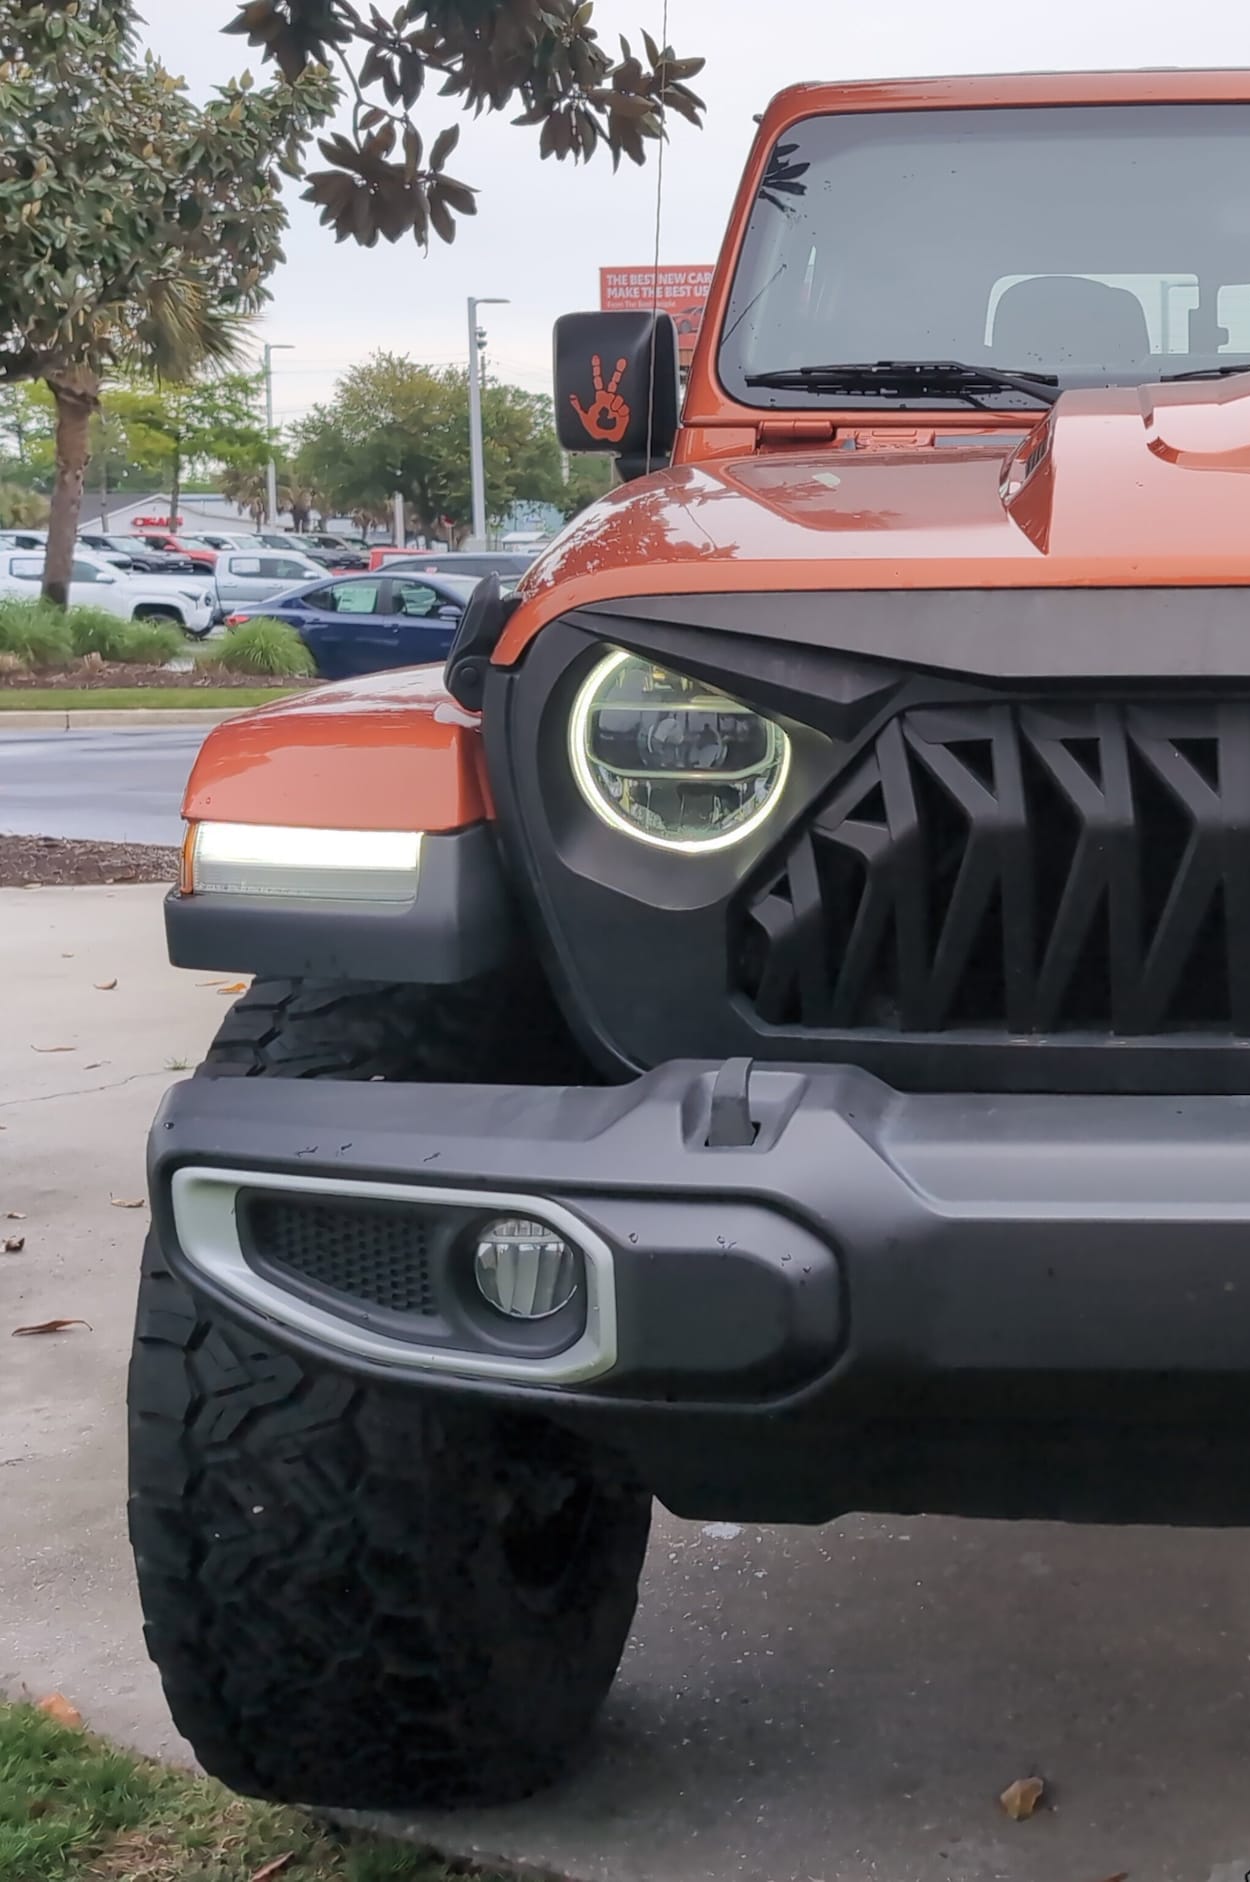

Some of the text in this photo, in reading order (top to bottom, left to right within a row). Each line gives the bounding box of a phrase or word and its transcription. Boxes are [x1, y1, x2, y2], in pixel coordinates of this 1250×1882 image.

[607, 274, 628, 285] THE
[630, 273, 655, 285] BEST
[659, 272, 686, 284] NEW
[607, 287, 640, 298] MAKE
[641, 286, 663, 298] THE
[665, 285, 692, 297] BEST
